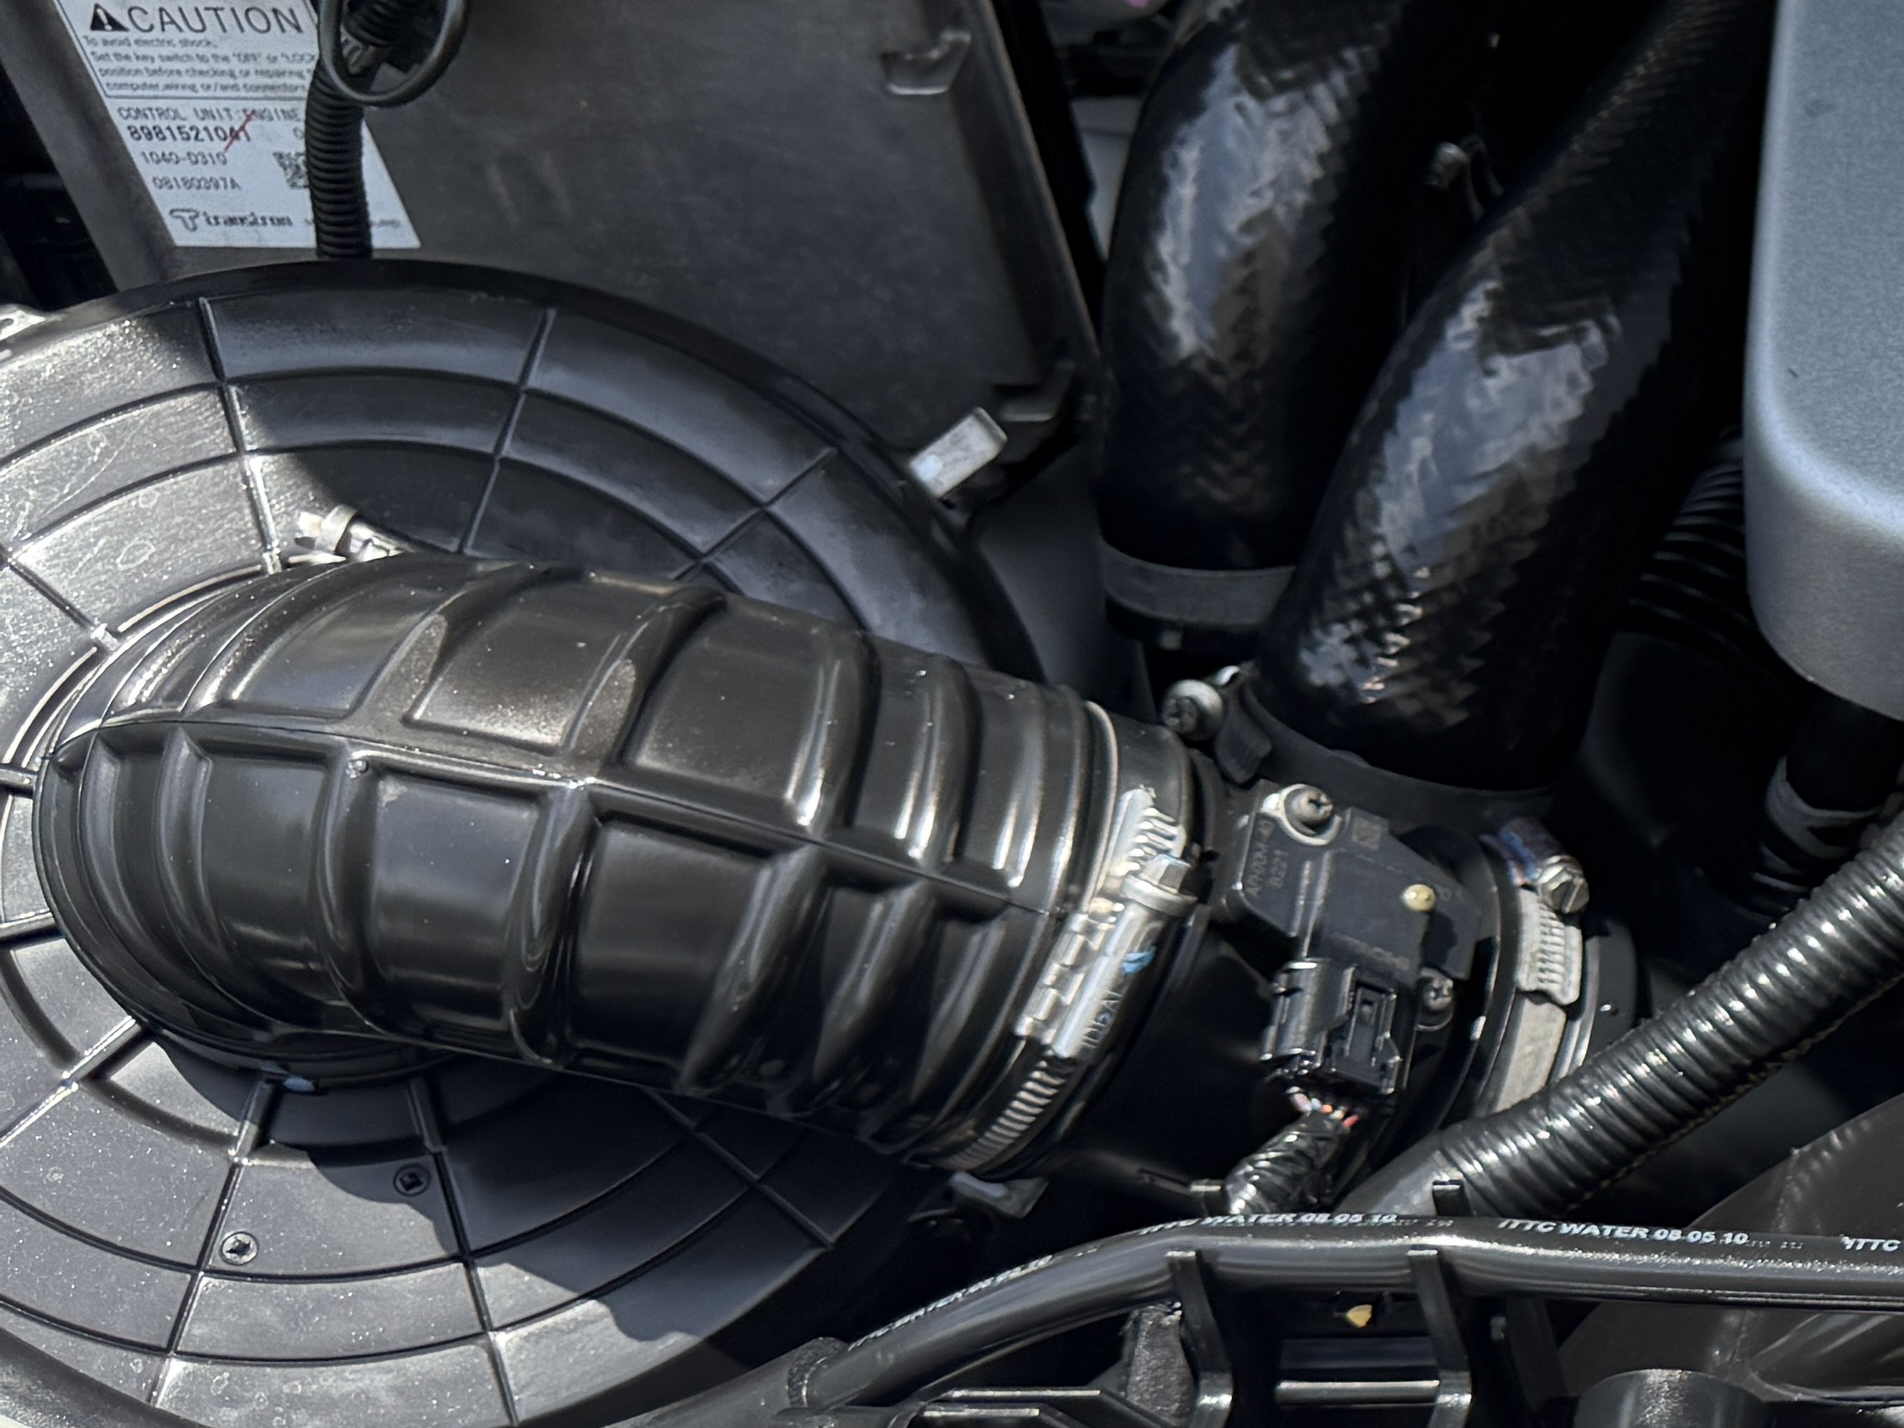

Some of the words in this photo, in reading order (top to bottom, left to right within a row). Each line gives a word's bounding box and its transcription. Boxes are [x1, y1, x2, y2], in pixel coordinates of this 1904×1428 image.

[126, 5, 304, 34] CAUTION
[117, 107, 187, 121] CONTROL
[1498, 1218, 1556, 1233] ITTC
[1559, 1222, 1650, 1239] WATER
[1653, 1229, 1682, 1242] 08
[1687, 1230, 1716, 1243] 05
[1721, 1232, 1749, 1245] 10
[1842, 1237, 1901, 1252] ITTC
